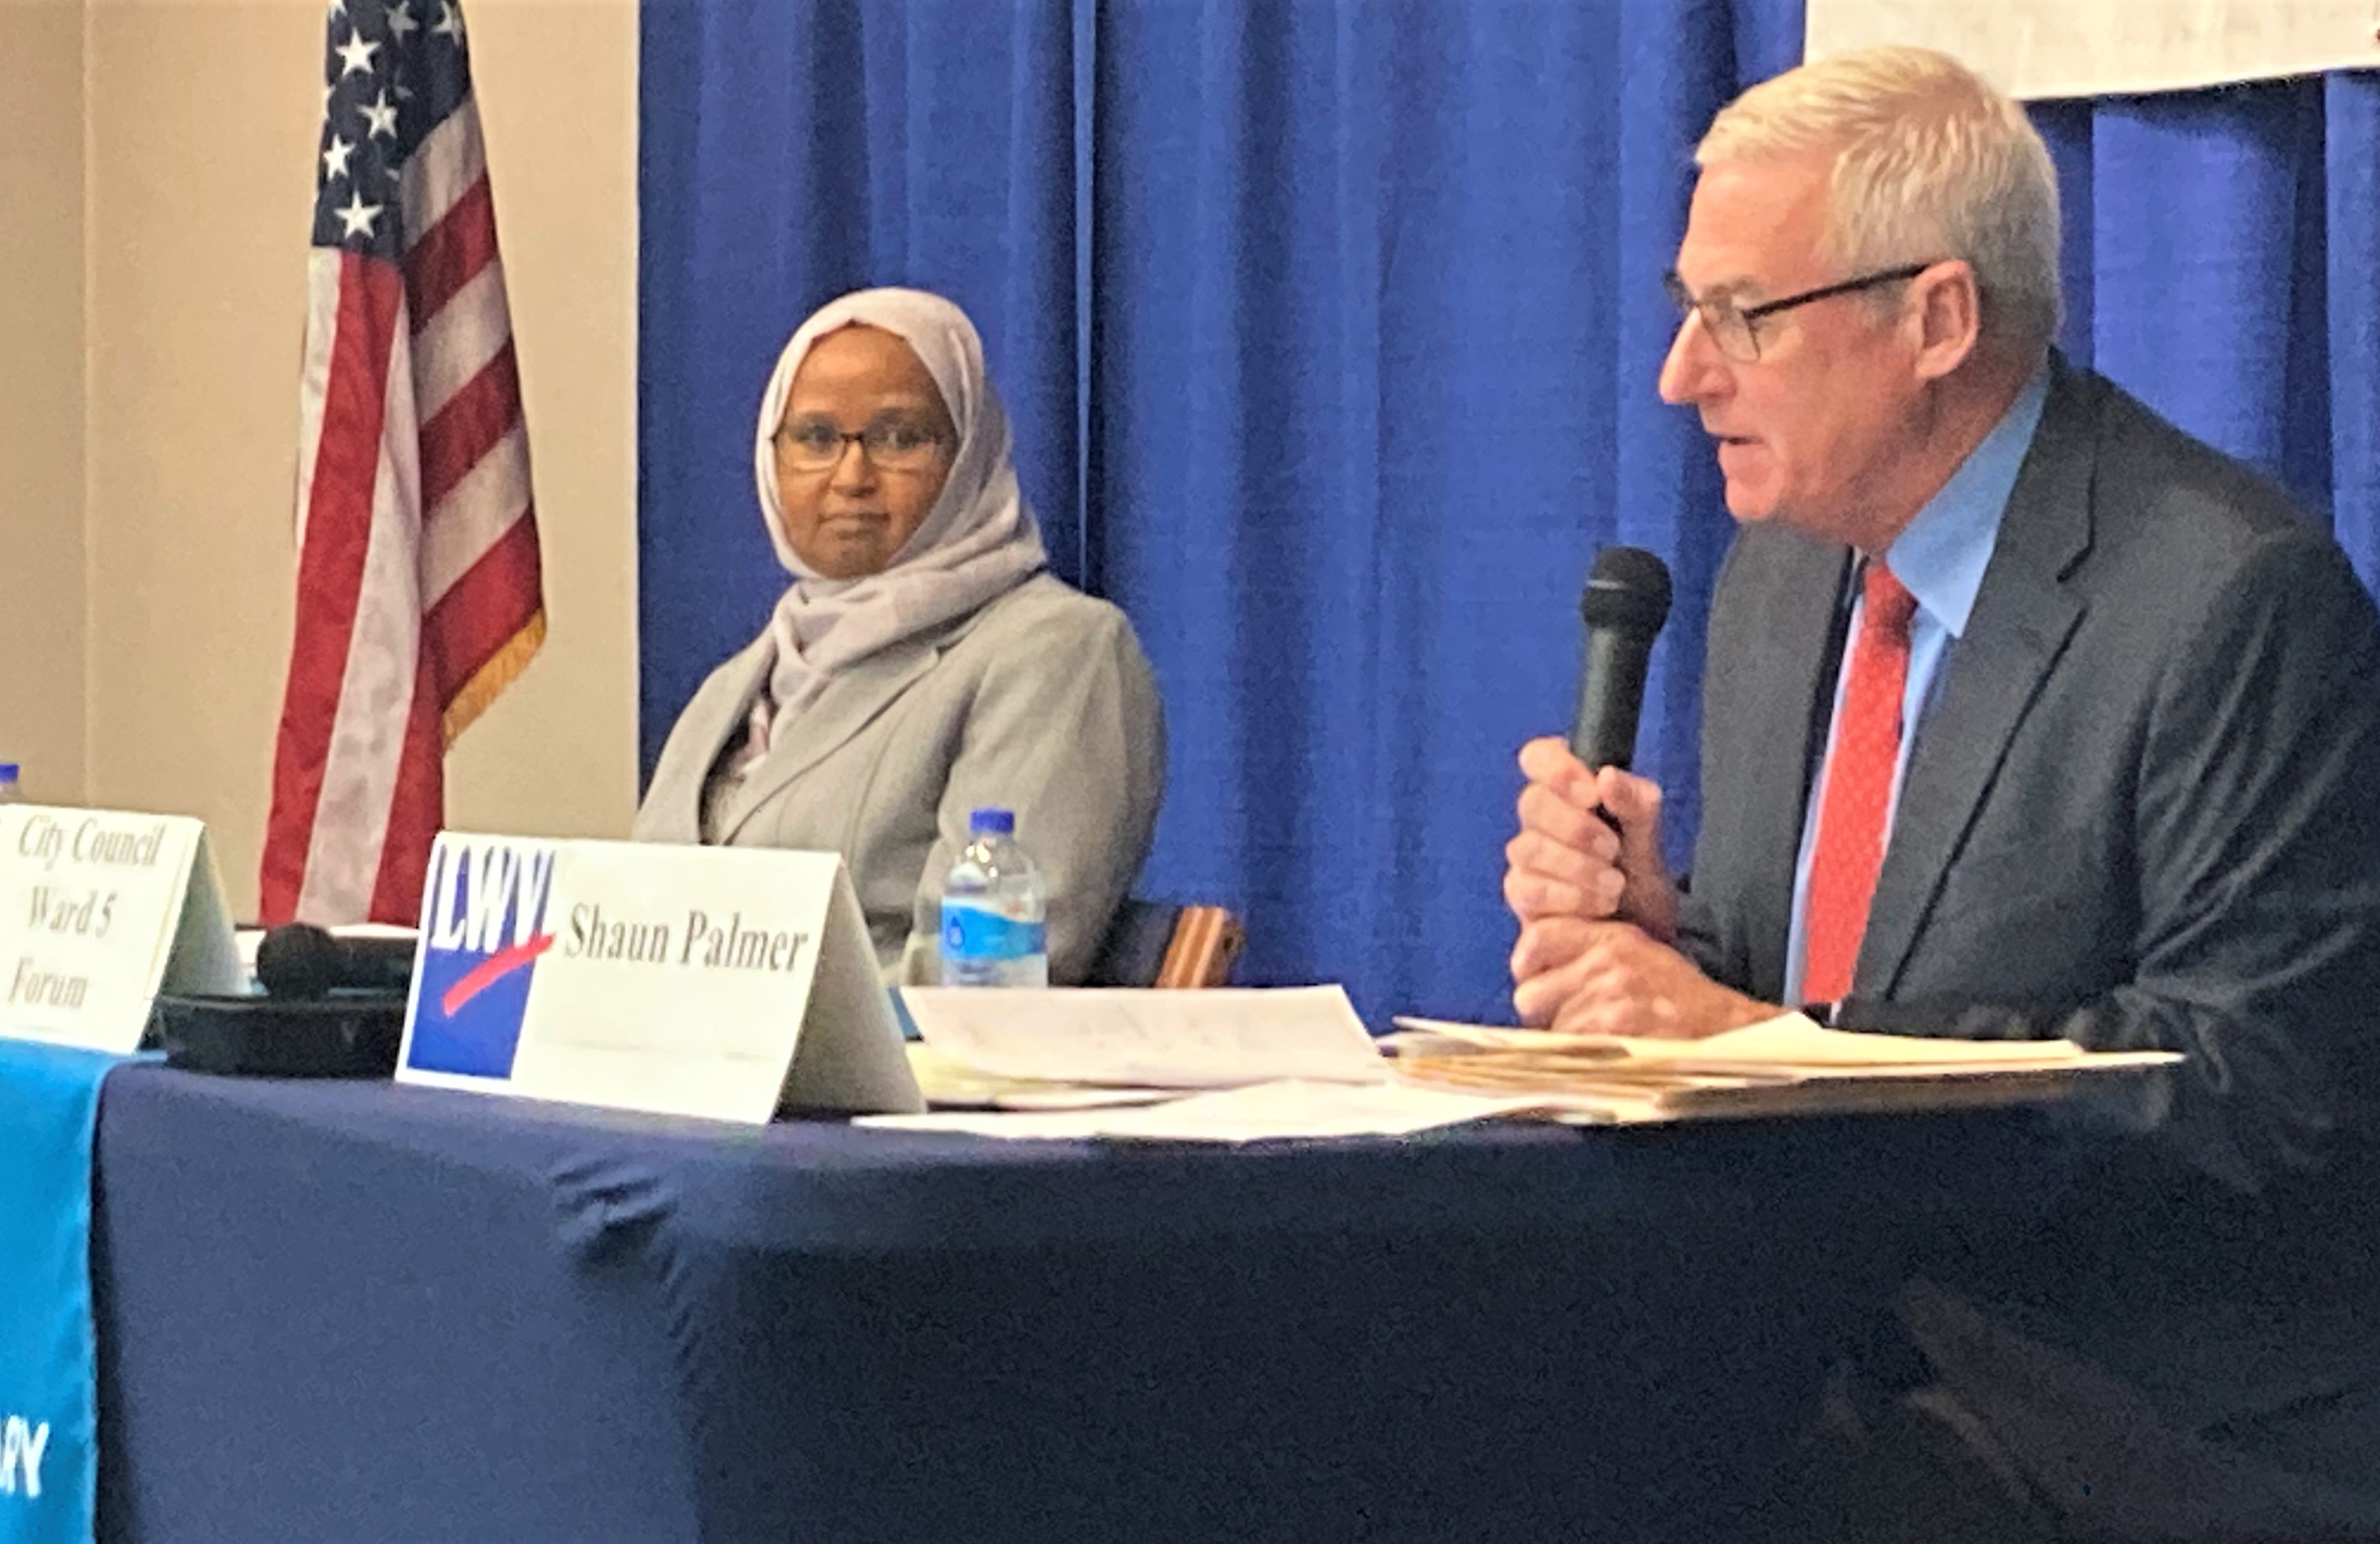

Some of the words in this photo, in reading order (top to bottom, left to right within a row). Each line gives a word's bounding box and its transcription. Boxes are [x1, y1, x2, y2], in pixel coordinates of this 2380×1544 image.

[18, 813, 67, 871] City
[73, 816, 168, 866] Council
[28, 885, 98, 935] Ward
[98, 892, 117, 937] 5
[432, 842, 552, 953] LWV
[564, 901, 669, 964] Shaun
[681, 909, 810, 973] Palmer
[8, 957, 90, 1009] Forum
